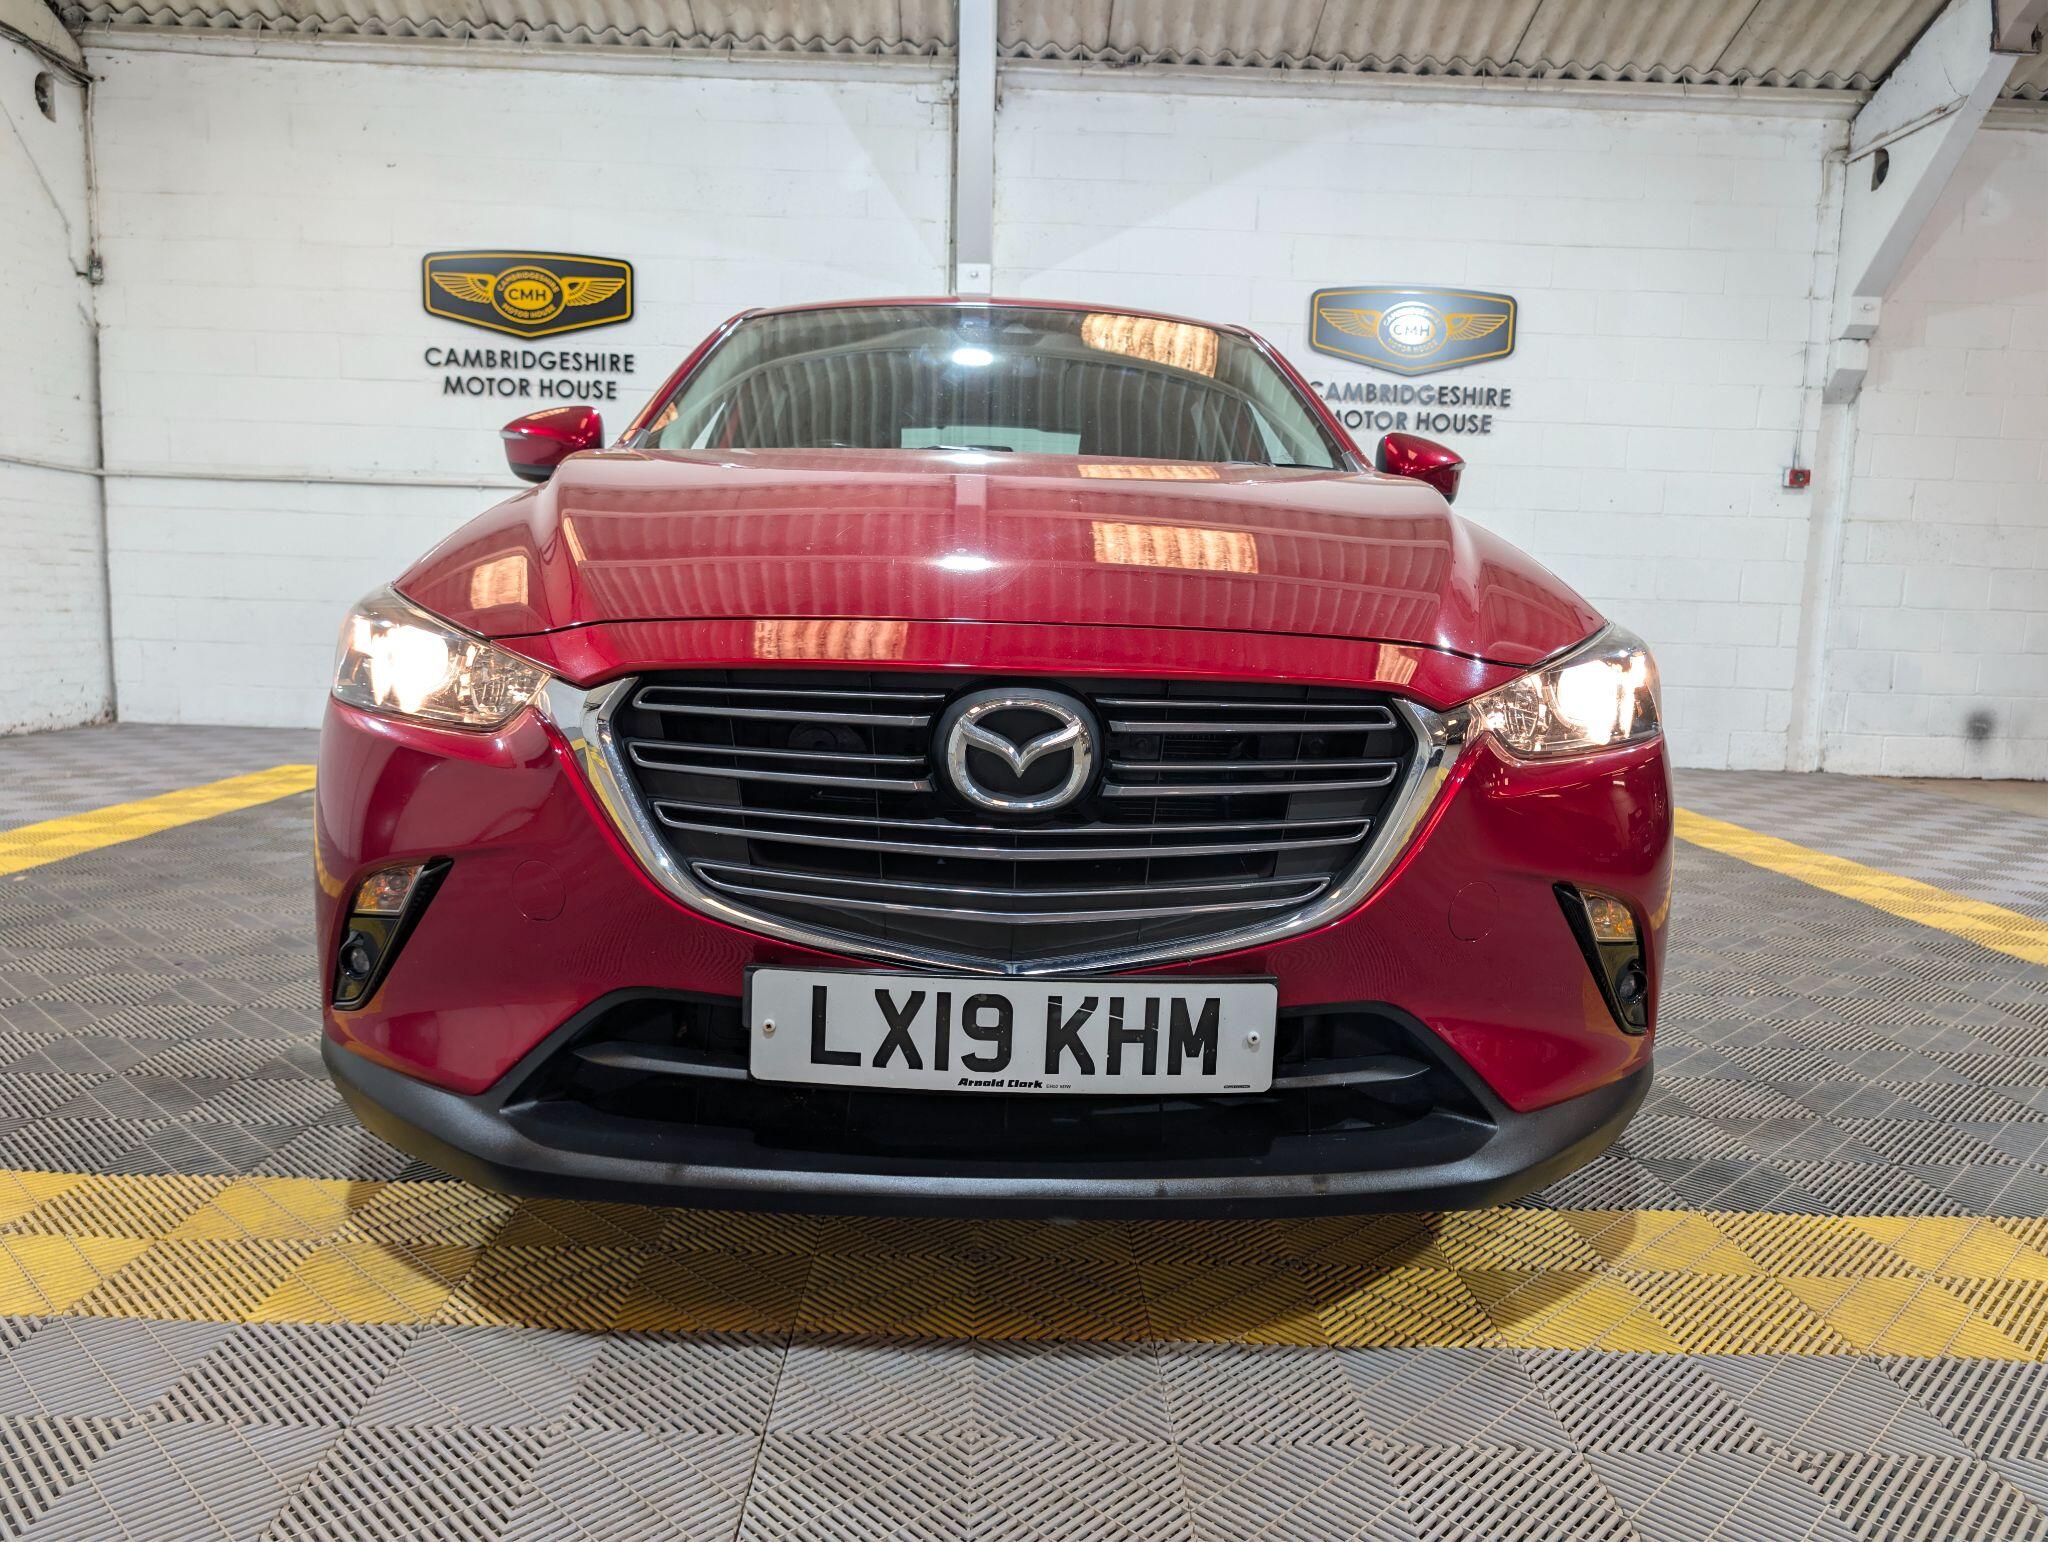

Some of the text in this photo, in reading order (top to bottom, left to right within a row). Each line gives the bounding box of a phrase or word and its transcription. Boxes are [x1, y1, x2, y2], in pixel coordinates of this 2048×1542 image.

[508, 288, 547, 301] CMH
[1393, 324, 1430, 336] CMH
[424, 347, 635, 373] CAMBRIDGESHIRE
[443, 376, 617, 399] MOTOR HOUSE
[1416, 411, 1493, 434] HOUSE
[810, 984, 1222, 1076] LX19 KHM
[957, 1077, 1005, 1088] Arnold
[1007, 1079, 1043, 1089] Clark
